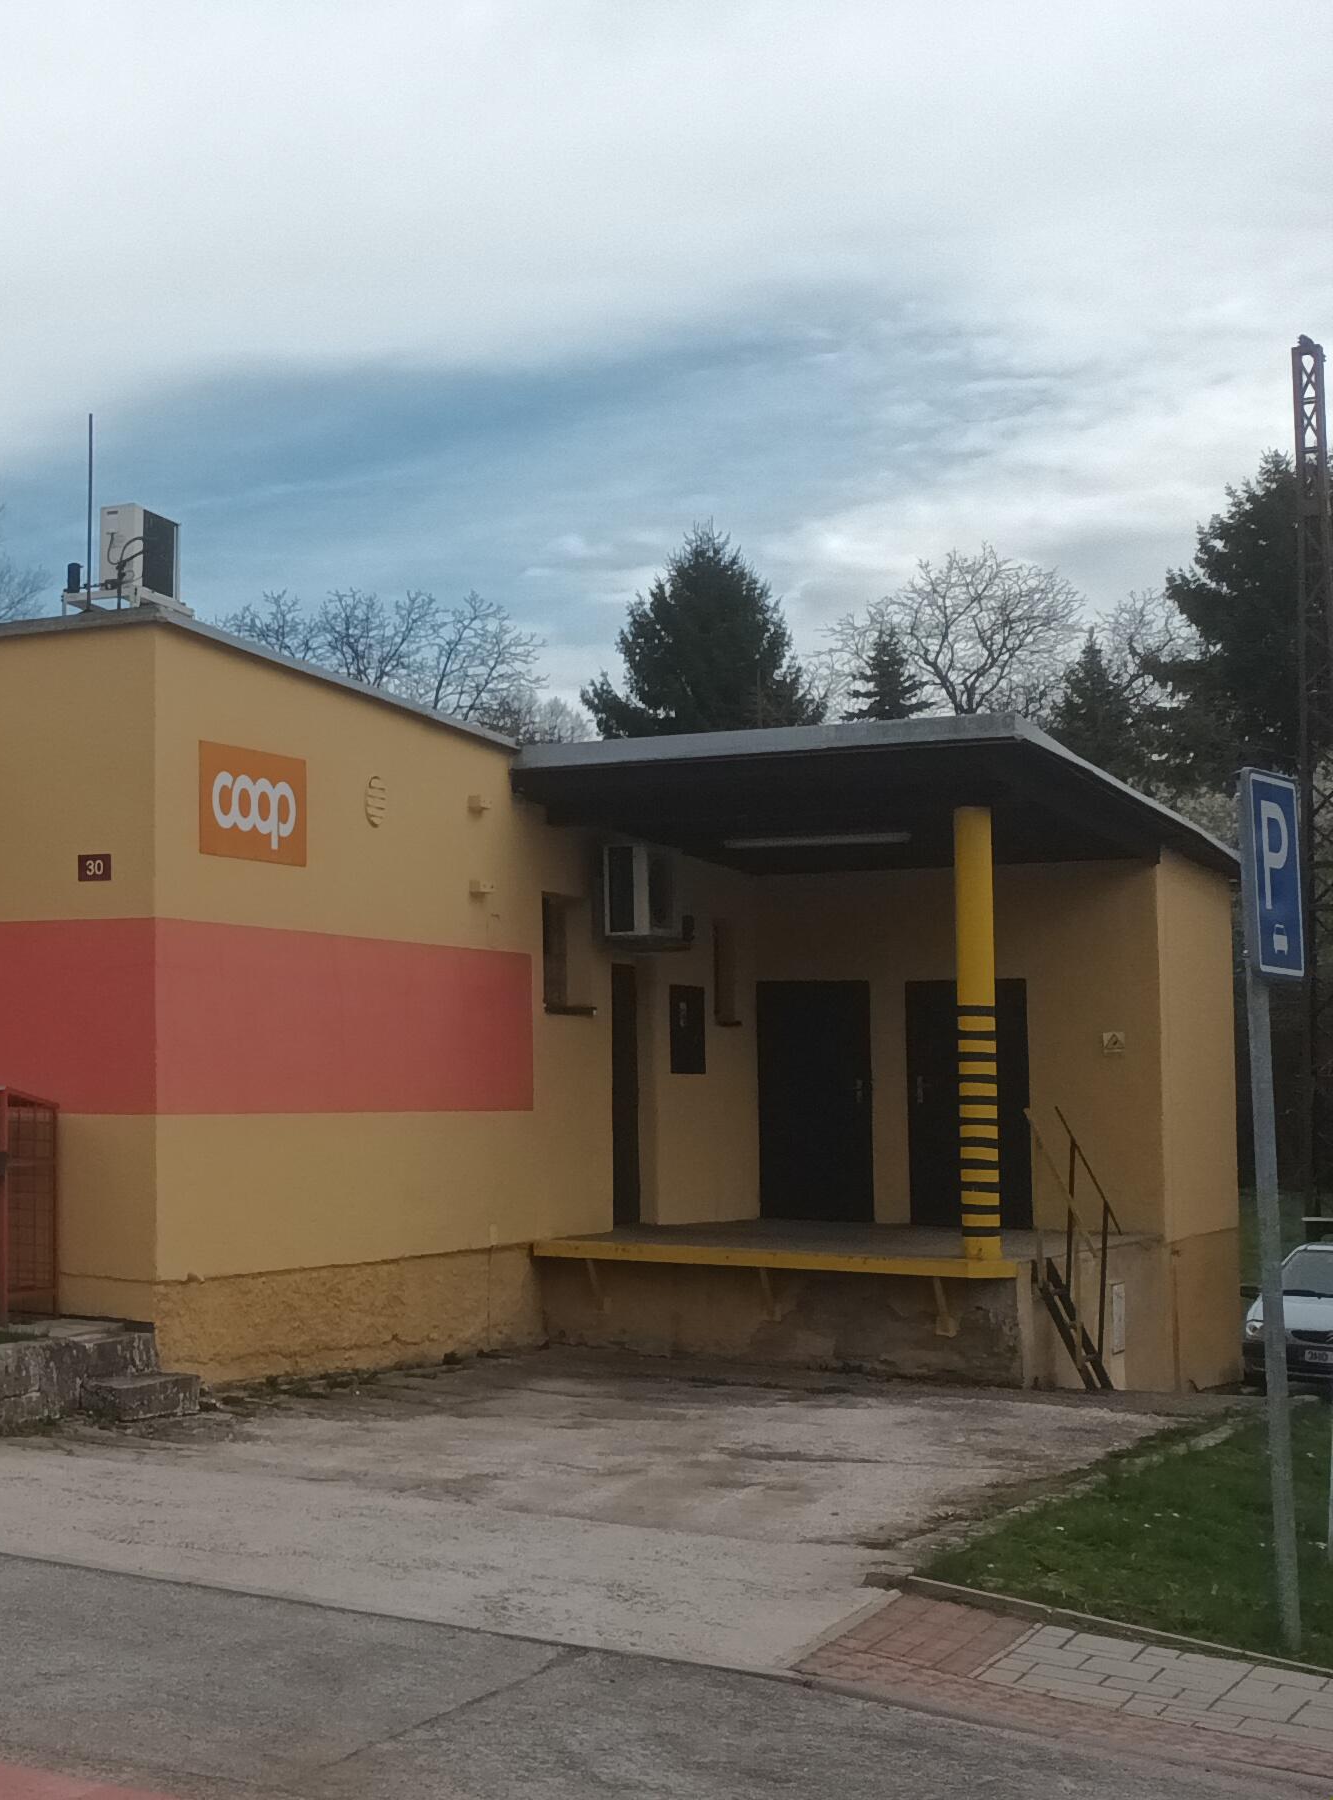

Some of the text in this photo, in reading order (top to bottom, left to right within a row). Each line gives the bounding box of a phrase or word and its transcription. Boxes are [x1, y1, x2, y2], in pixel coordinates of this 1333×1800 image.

[212, 771, 296, 850] coop
[85, 859, 104, 876] 30
[1261, 800, 1289, 910] P
